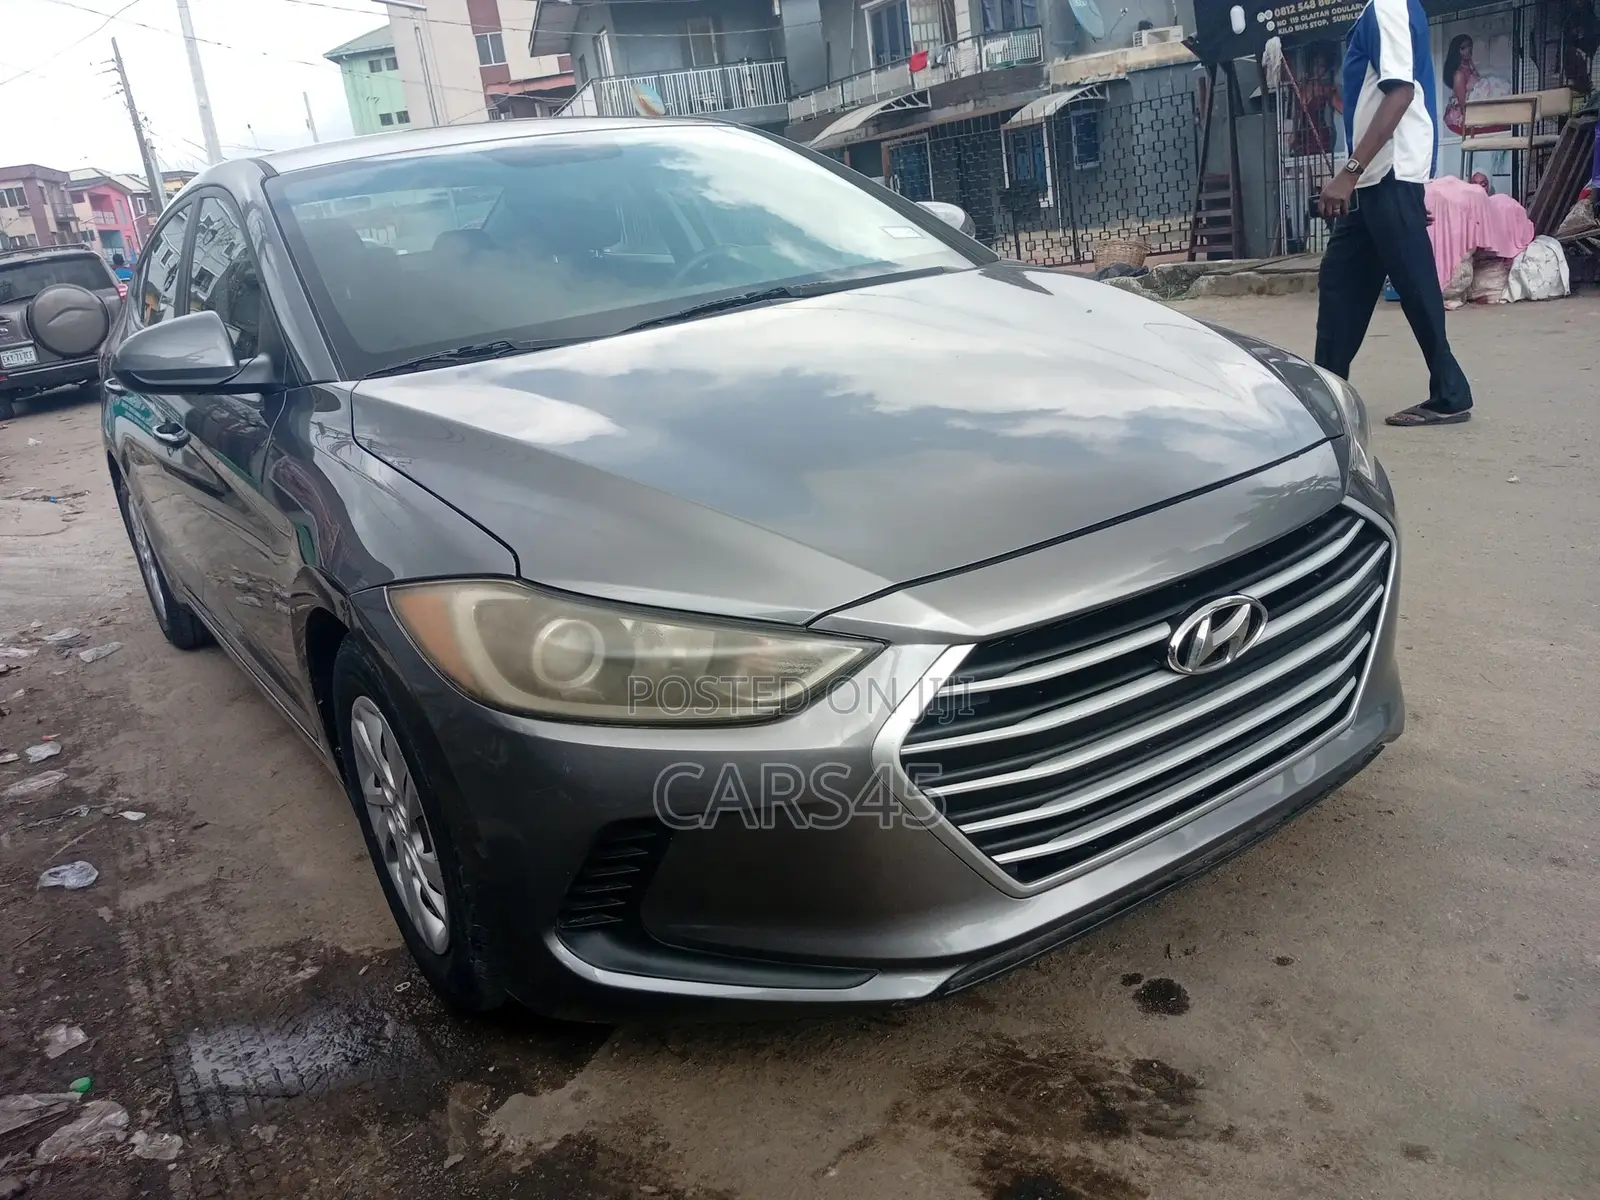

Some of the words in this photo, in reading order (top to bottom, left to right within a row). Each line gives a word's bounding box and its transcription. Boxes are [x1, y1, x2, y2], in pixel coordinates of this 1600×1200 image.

[1274, 4, 1296, 17] 0812
[1297, 0, 1316, 12] 548
[1276, 19, 1287, 27] NO
[1290, 16, 1299, 24] 119
[1300, 9, 1330, 21] OLAITAN
[1278, 26, 1294, 35] KILO
[1294, 22, 1309, 31] BUS
[1309, 19, 1329, 29] STOP,
